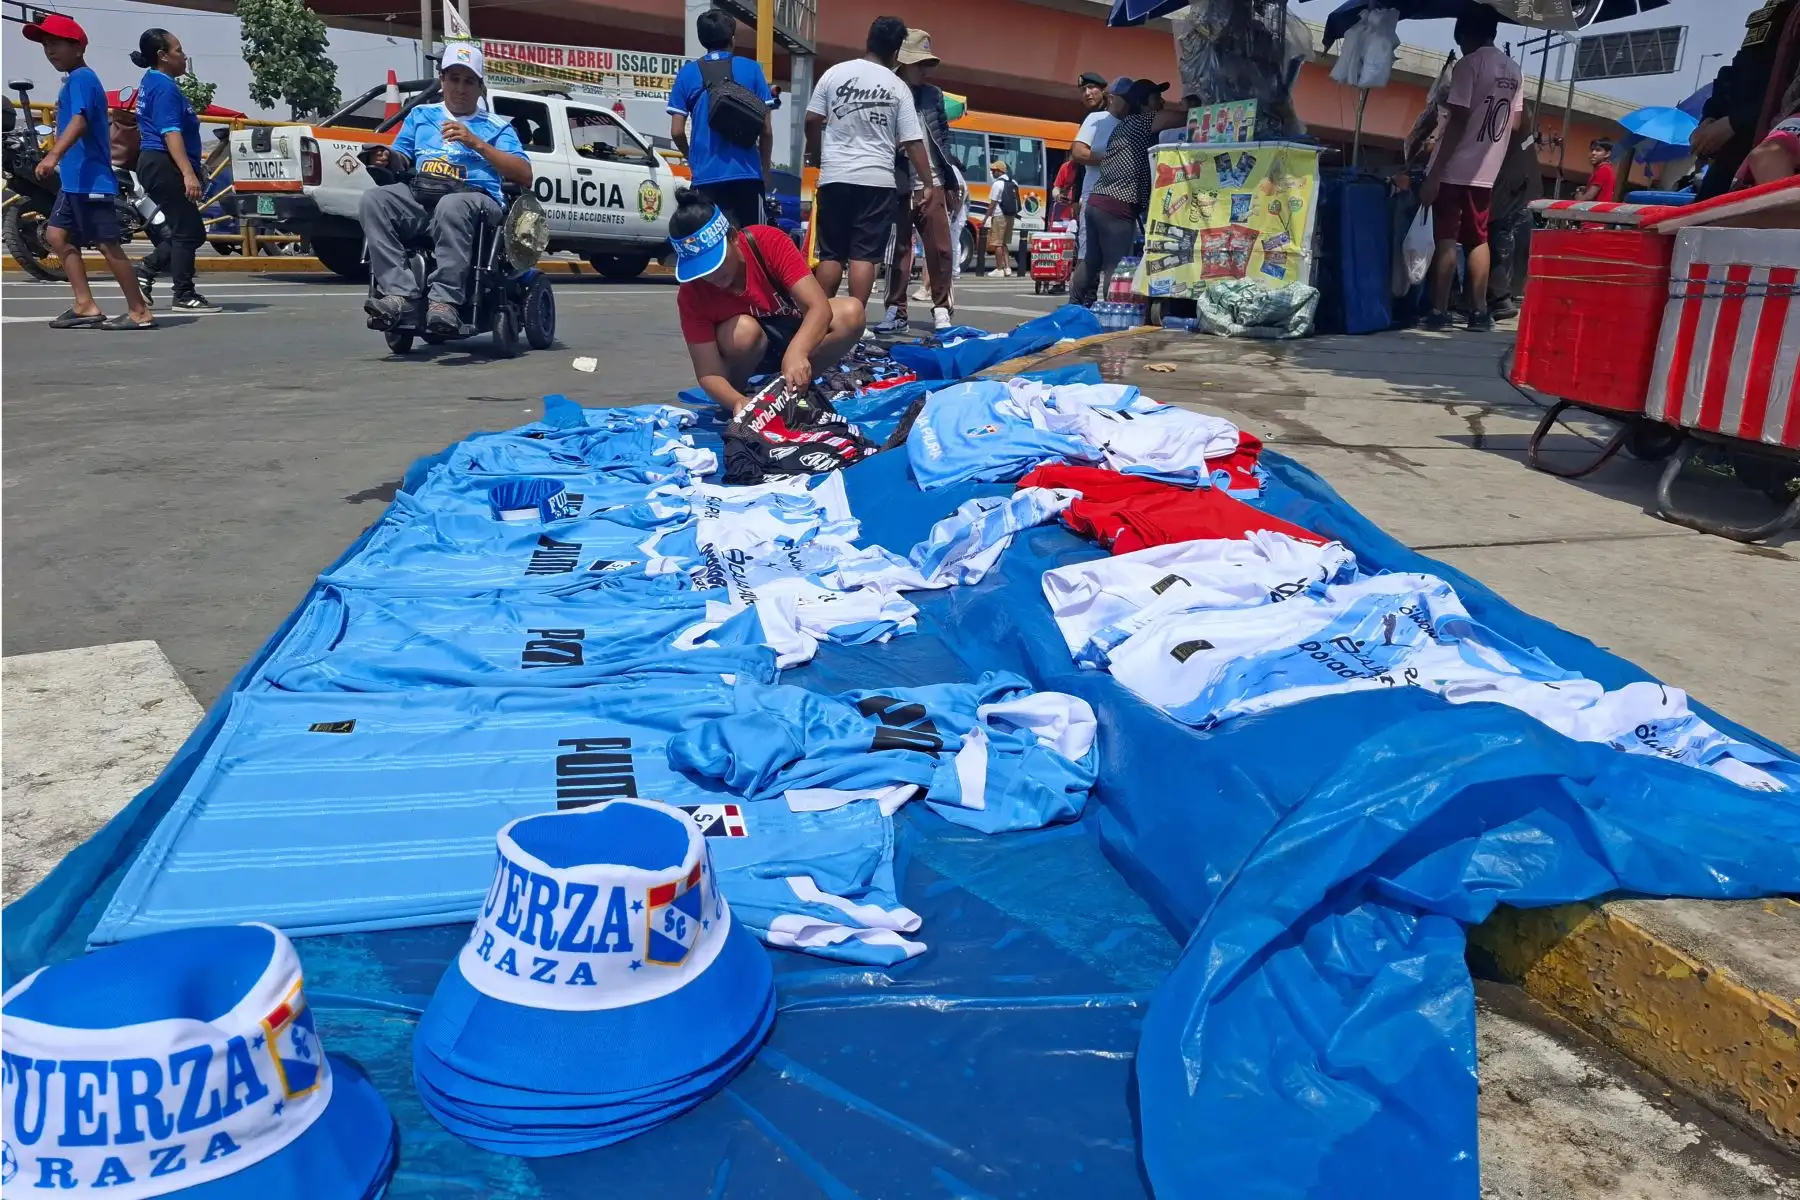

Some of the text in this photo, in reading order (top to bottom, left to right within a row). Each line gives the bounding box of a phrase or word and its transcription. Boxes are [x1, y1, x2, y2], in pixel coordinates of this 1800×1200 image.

[484, 42, 564, 67] ALEXANDER
[567, 48, 613, 70] ABREU
[617, 53, 658, 74] ISSAC
[633, 75, 664, 89] EREZ
[635, 90, 663, 99] ENCIA
[1477, 95, 1511, 143] 10
[332, 143, 360, 152] UPAT
[248, 161, 286, 179] POLICIA
[421, 161, 461, 179] CRISTAL
[534, 176, 625, 209] OLICIA
[568, 211, 578, 221] DE
[580, 212, 625, 225] ACCIDENTES
[1298, 640, 1362, 679] Dorad
[556, 737, 638, 811] PUM
[484, 853, 634, 953] UERZA
[476, 930, 598, 986] RAZA
[34, 1130, 241, 1189] RAZA
